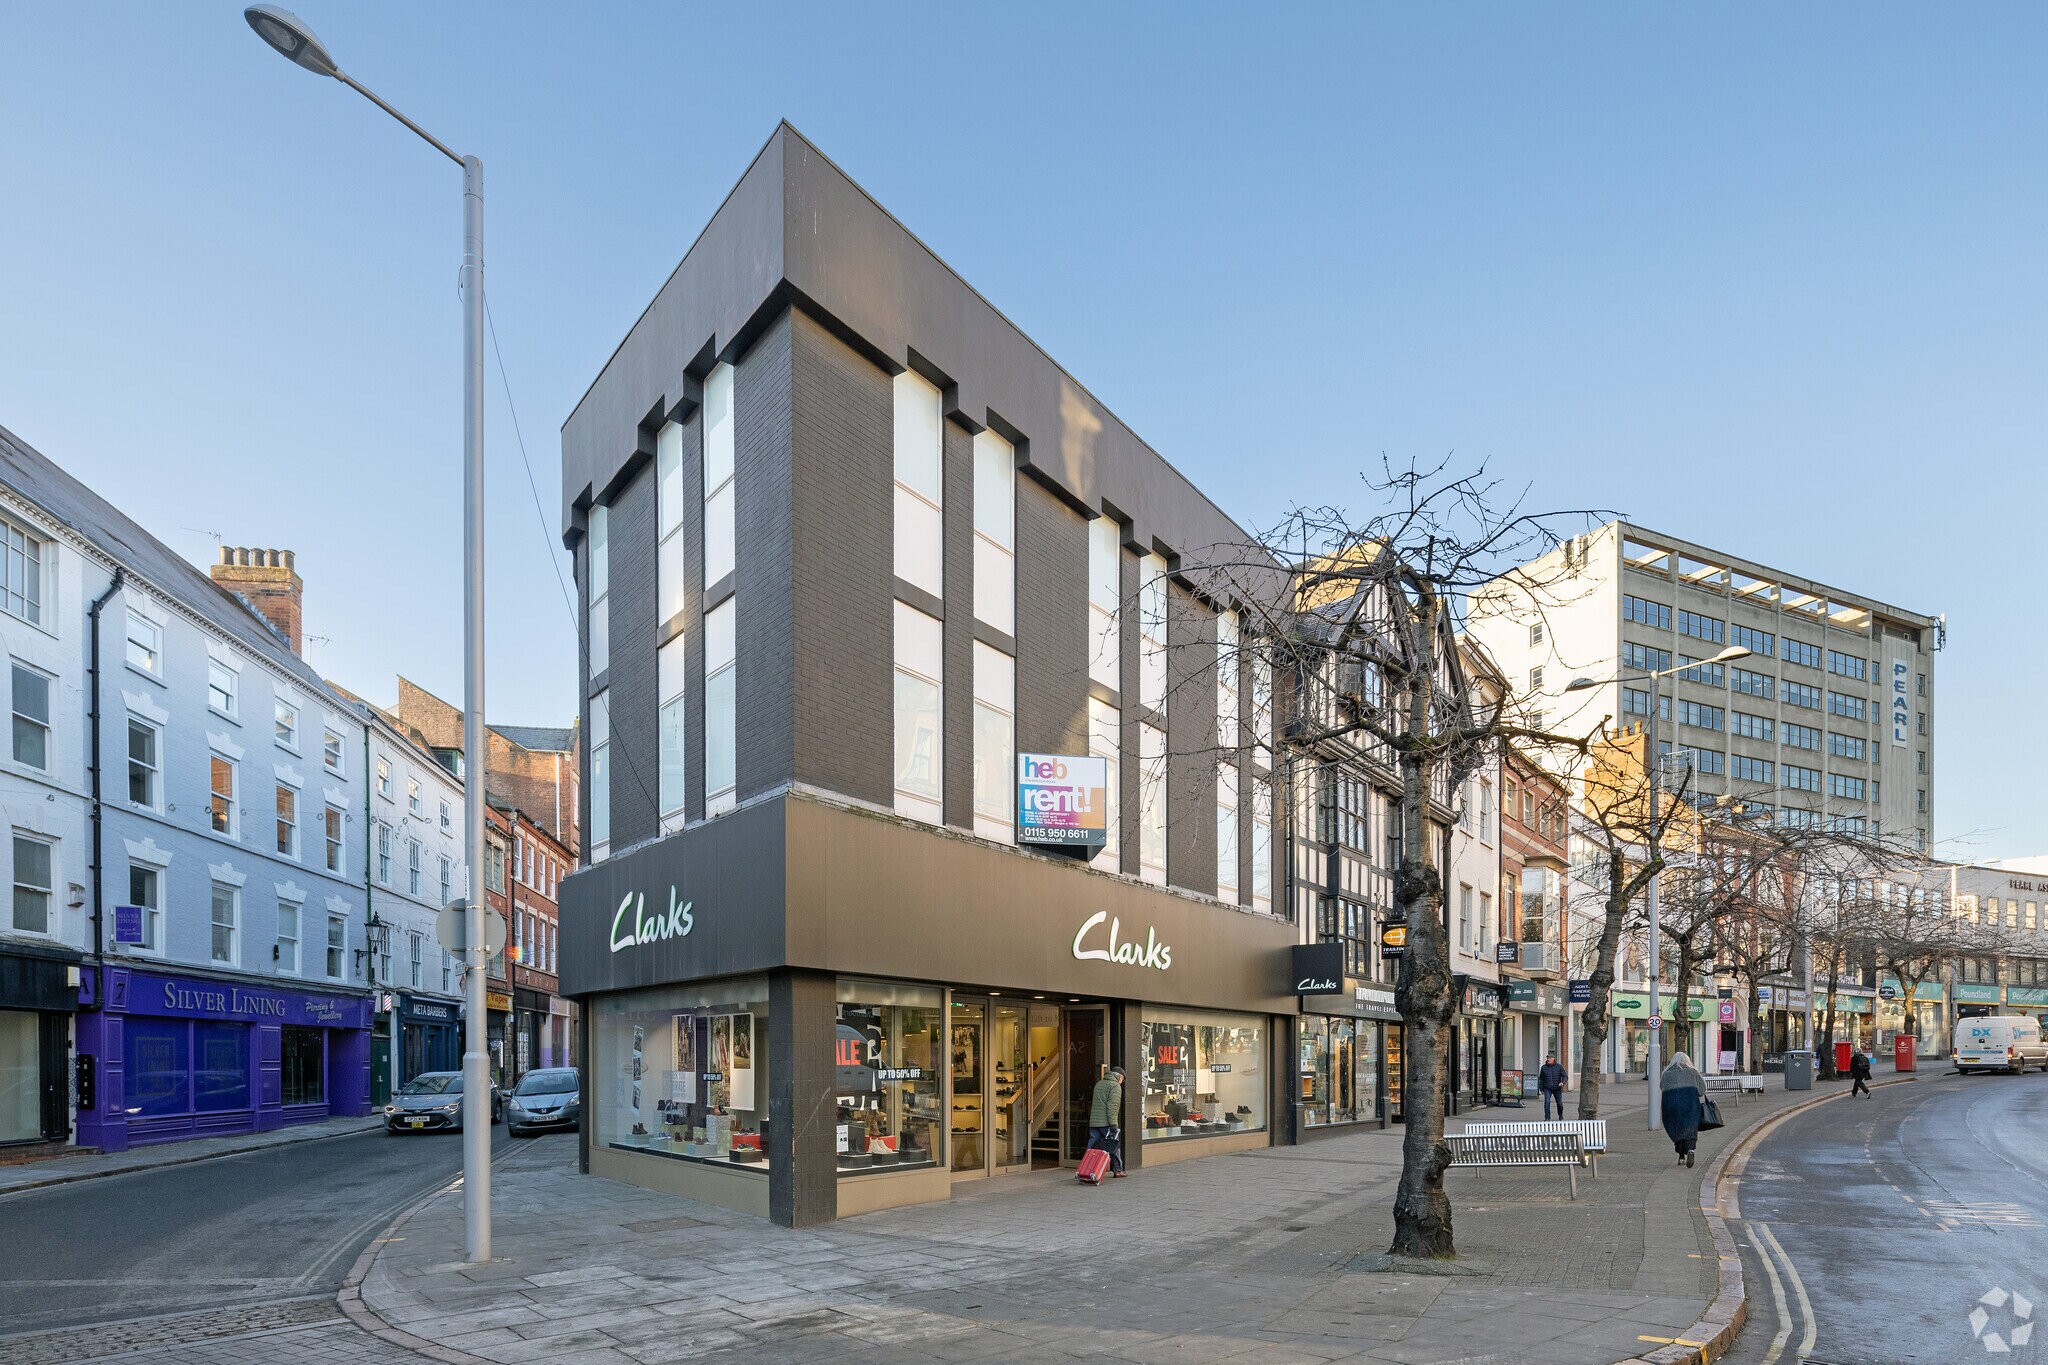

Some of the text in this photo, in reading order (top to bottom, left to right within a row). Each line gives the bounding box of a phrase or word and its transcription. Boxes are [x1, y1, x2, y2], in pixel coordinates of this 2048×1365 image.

[1893, 663, 1907, 742] PEARL
[1024, 756, 1068, 780] heb
[1024, 786, 1092, 813] rent!
[1025, 827, 1088, 838] 0115 950 6611
[2009, 880, 2048, 892] PEARL AS
[610, 885, 694, 953] Clarks
[1072, 910, 1171, 970] Clarks
[117, 982, 126, 999] 7
[1298, 978, 1337, 990] Clarks
[164, 982, 286, 1017] SILVER LINING
[1960, 988, 1991, 999] Poundland
[2012, 991, 2044, 1001] Poundland
[413, 1003, 447, 1018] META BARBERS
[1366, 1004, 1381, 1012] TRAVEL
[1383, 1006, 1398, 1014] EXPER
[1971, 1027, 1992, 1037] DX
[1157, 1045, 1178, 1064] SALE
[878, 1068, 921, 1079] UP TO 50% OFF
